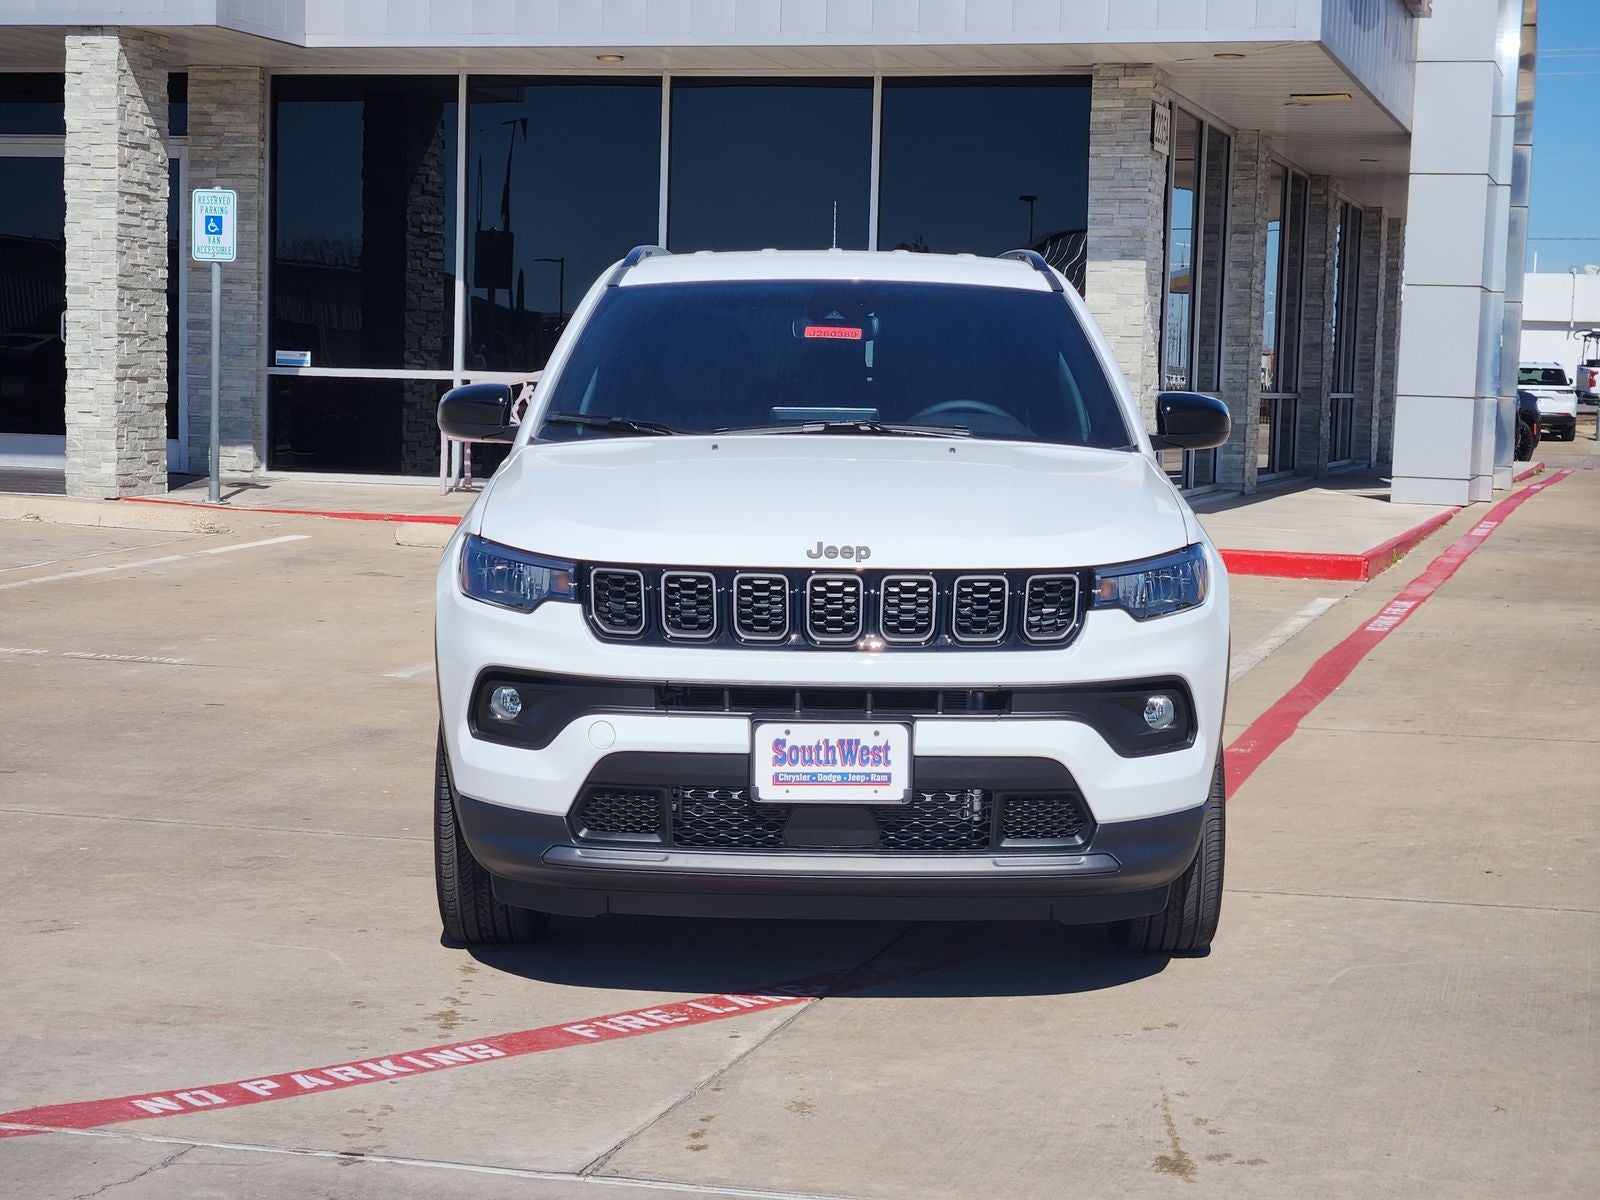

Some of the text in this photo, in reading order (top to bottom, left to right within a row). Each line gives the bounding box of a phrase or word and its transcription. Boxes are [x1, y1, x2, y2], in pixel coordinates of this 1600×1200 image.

[198, 195, 231, 205] RESERVED
[200, 205, 229, 215] PARKING
[207, 236, 221, 245] VAN
[196, 245, 232, 255] ACCESSIBLE
[806, 541, 871, 562] Jeep
[772, 738, 892, 767] SouthWest
[778, 773, 888, 783] Chrysler Dodge Jeep Ram
[131, 1090, 228, 1115] NO
[238, 1043, 507, 1096] PARKING
[561, 1009, 690, 1039] FIRE
